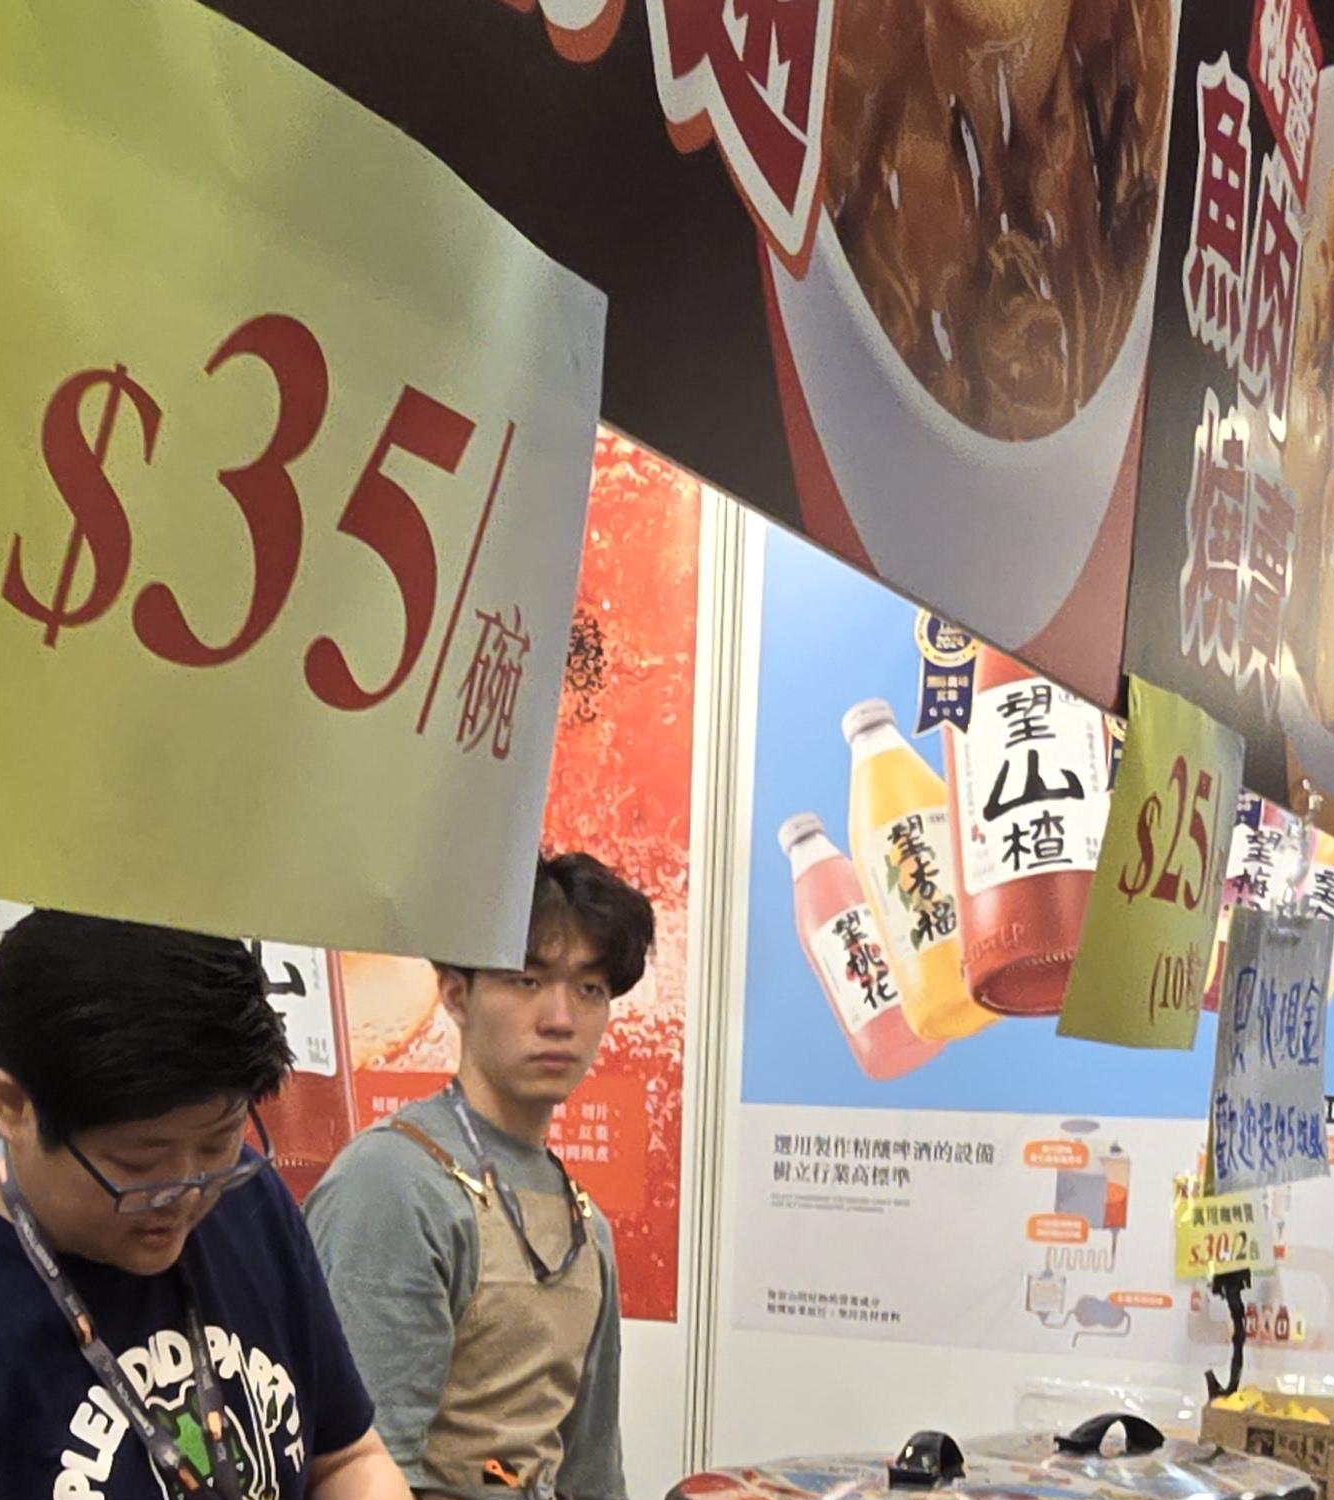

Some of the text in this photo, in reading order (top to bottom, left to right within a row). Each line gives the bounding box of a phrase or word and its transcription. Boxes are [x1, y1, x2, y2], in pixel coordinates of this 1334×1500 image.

[1, 313, 531, 760] $35/碗
[982, 684, 1086, 872] 望山楂
[887, 814, 958, 942] 望杏福
[832, 910, 898, 1011] 望桃花
